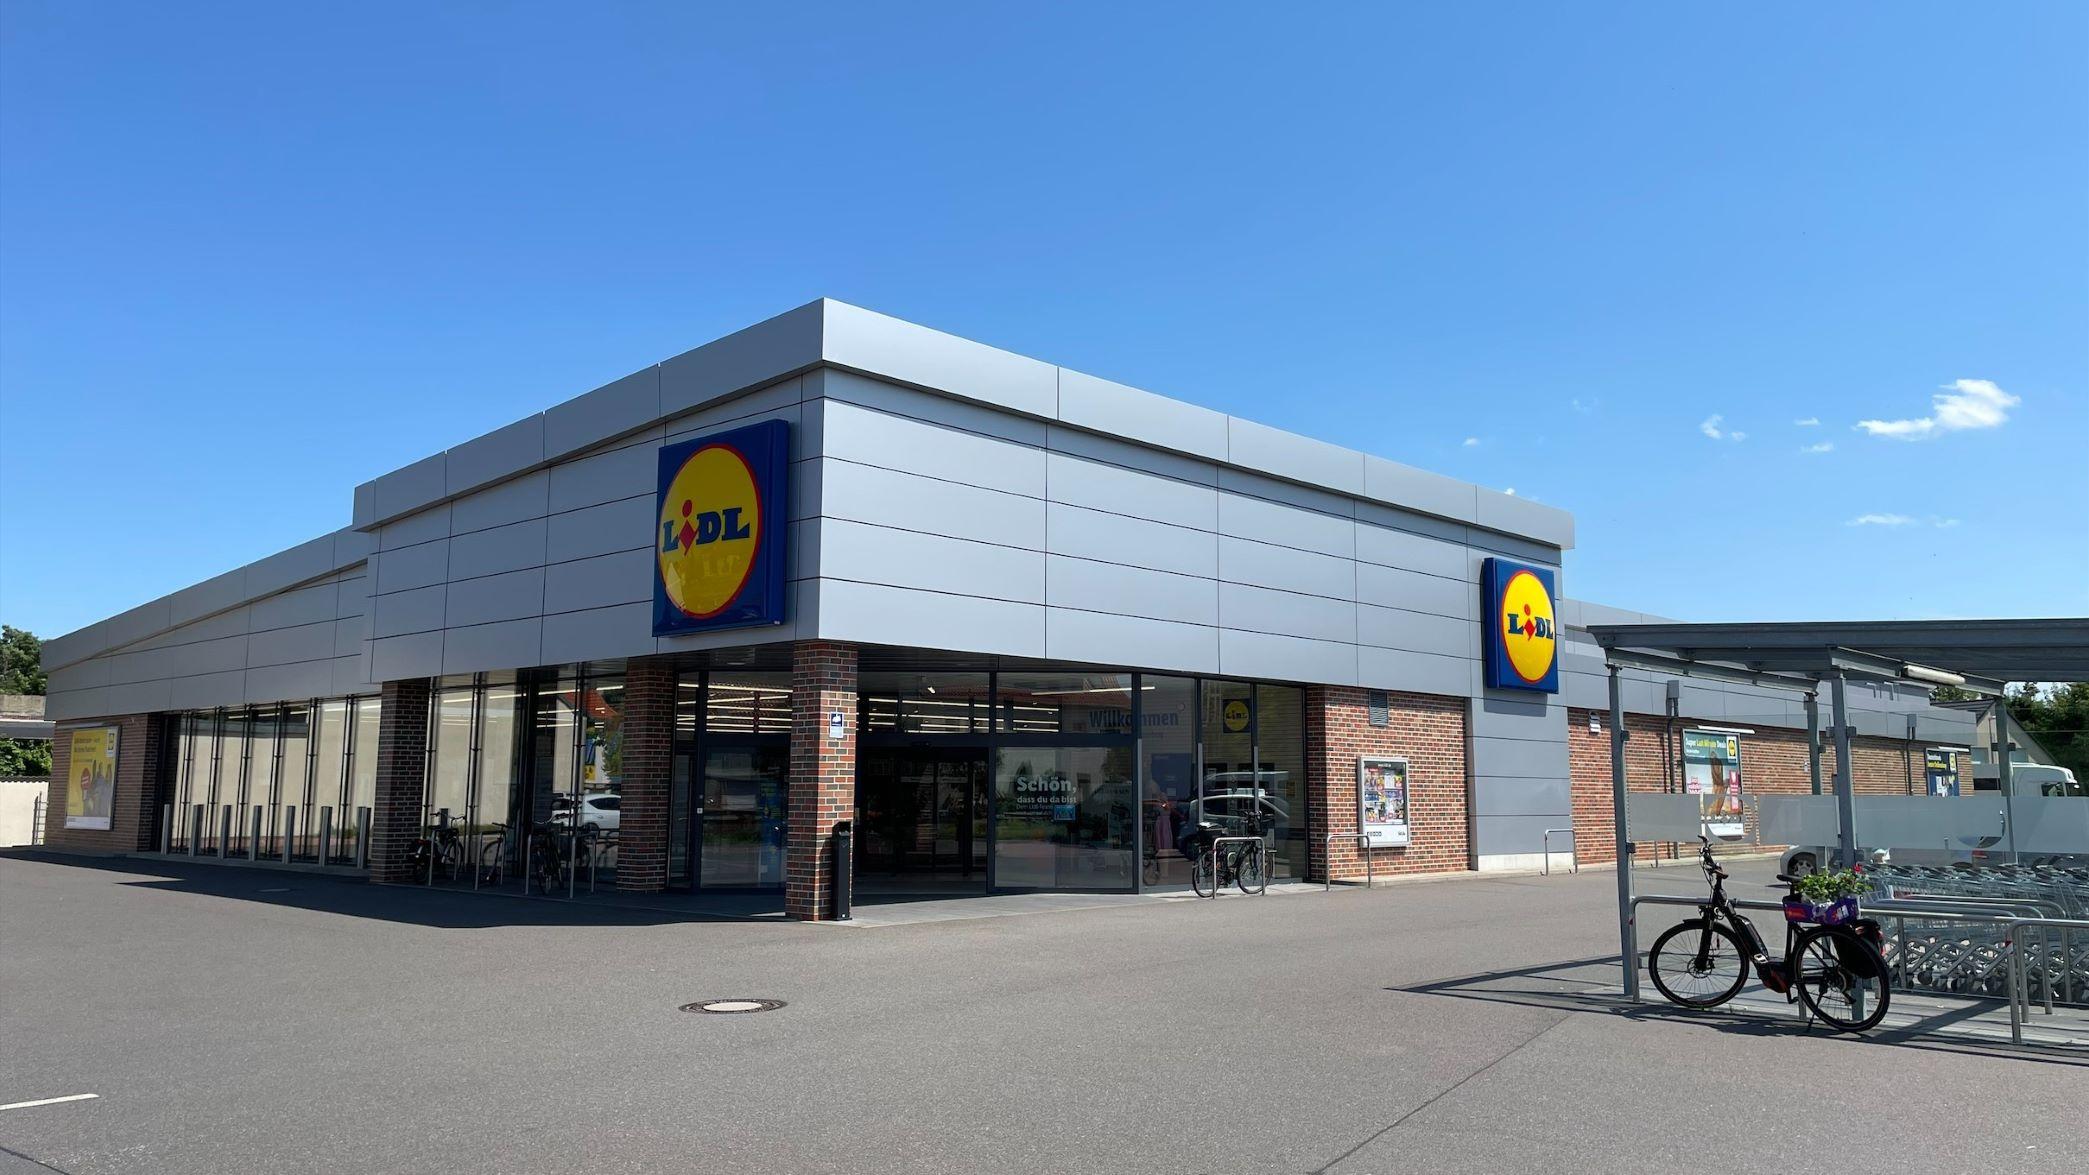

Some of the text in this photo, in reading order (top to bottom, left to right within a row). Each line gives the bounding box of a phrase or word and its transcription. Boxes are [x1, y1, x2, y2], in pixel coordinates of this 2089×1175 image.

[1089, 709, 1179, 728] Willkommen
[1016, 775, 1077, 793] Schön,
[1016, 795, 1077, 804] dass du da bist
